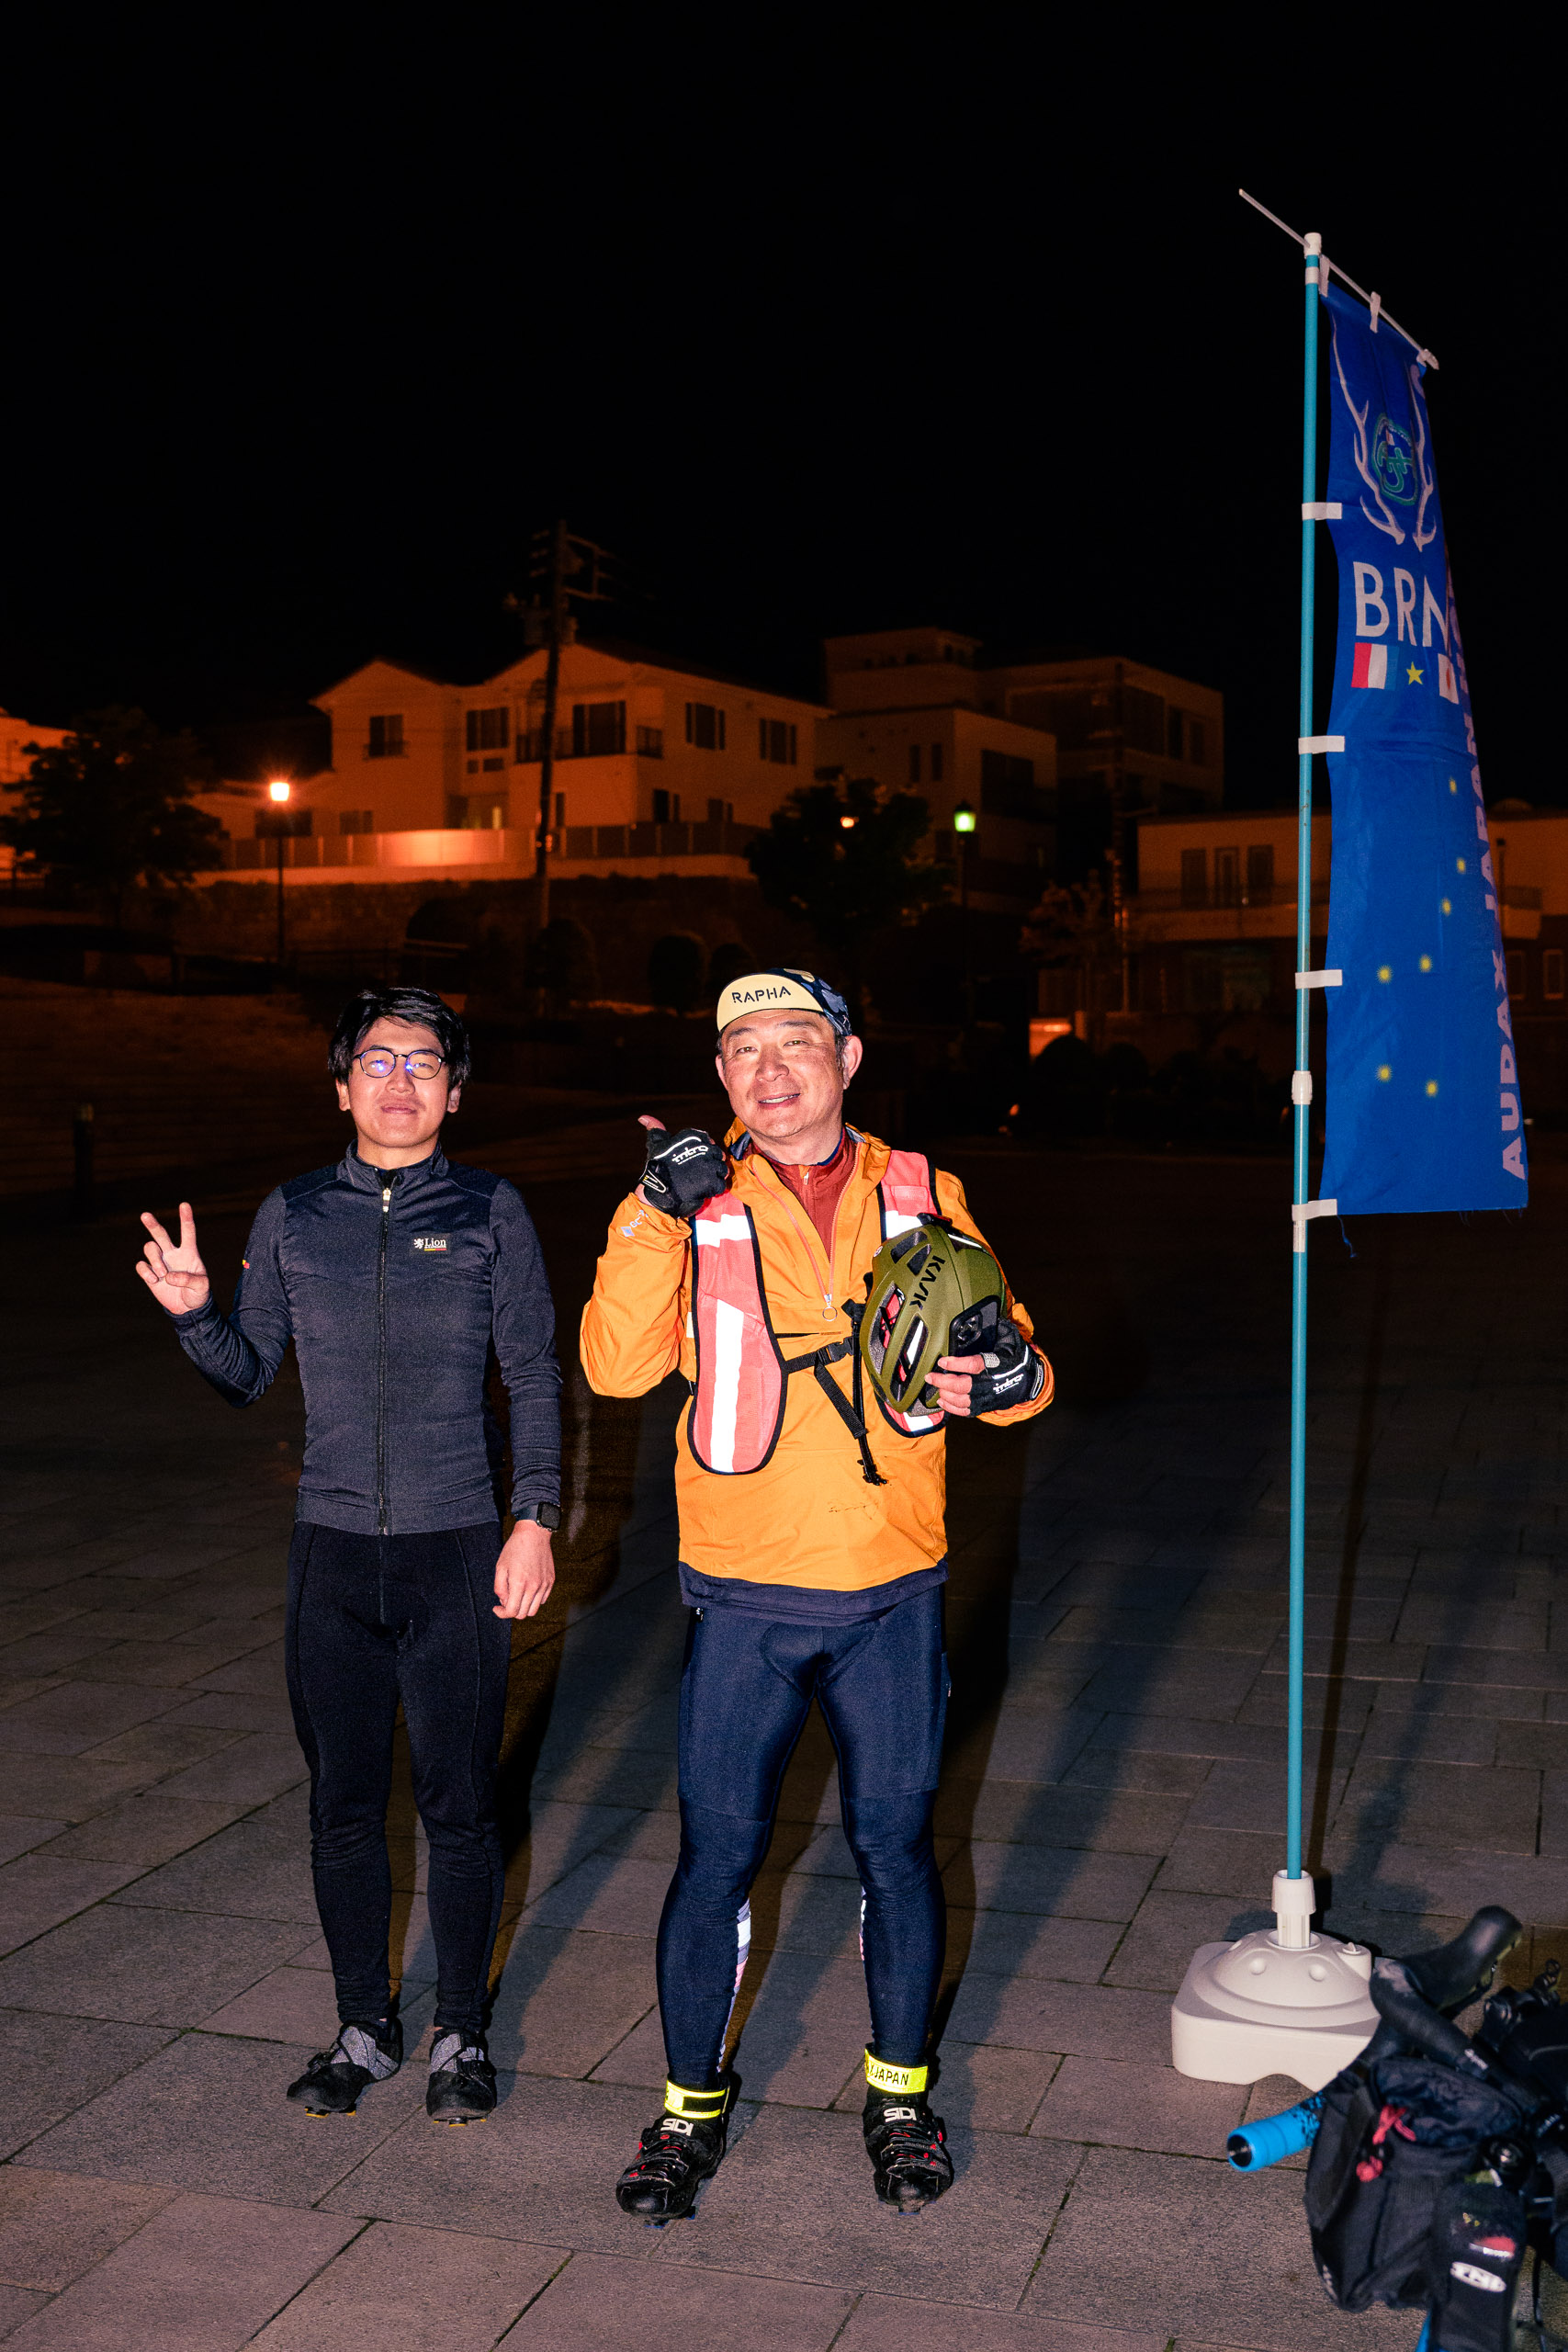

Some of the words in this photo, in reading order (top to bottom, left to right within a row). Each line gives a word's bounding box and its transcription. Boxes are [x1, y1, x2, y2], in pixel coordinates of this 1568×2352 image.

[731, 986, 792, 1003] RAPHA
[1492, 949, 1526, 1181] AUDAX
[424, 1238, 446, 1247] Lion
[909, 1255, 946, 1310] KASK
[874, 2066, 908, 2086] JAPAN
